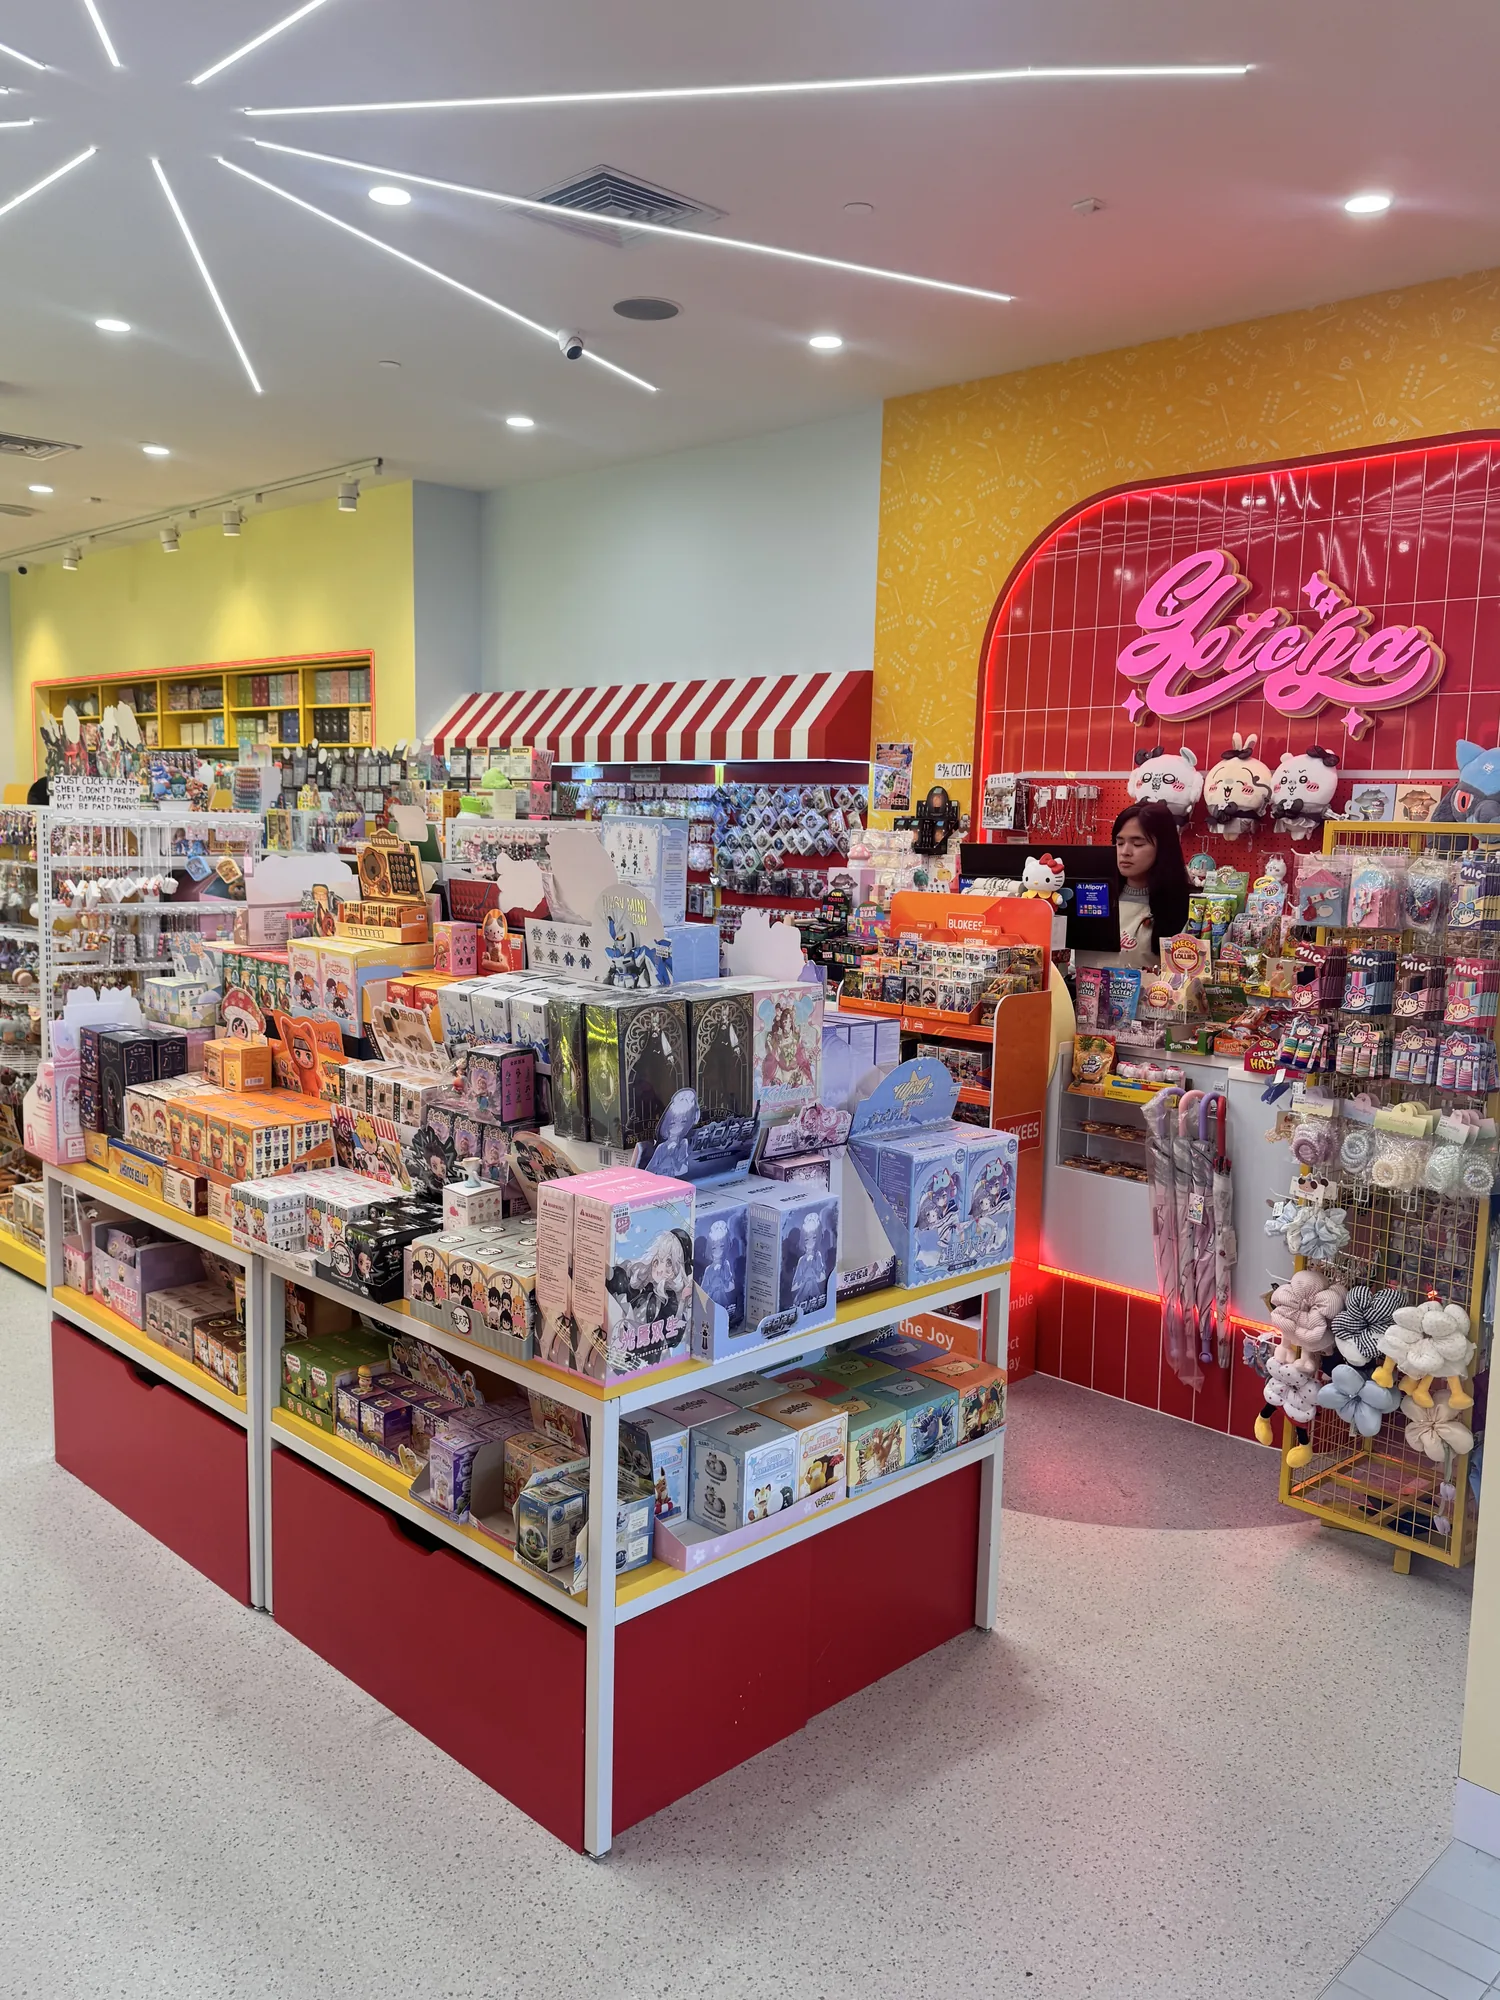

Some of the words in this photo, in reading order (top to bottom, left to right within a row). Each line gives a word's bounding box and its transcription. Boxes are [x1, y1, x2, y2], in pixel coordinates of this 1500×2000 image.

[1117, 550, 1440, 720] Gotcha
[951, 764, 971, 777] CCTV!
[55, 776, 79, 785] JUST
[82, 776, 103, 786] CLICK
[86, 786, 106, 794] DON'T
[109, 787, 126, 795] TAKE
[79, 795, 112, 803] DAMAGED
[626, 897, 647, 914] MINI
[948, 918, 983, 931] BLOKEES
[1173, 940, 1197, 951] MEGA
[1109, 982, 1132, 990] SOUR
[1004, 1121, 1039, 1141] OKEES
[899, 1319, 923, 1337] the
[927, 1327, 954, 1351] Joy
